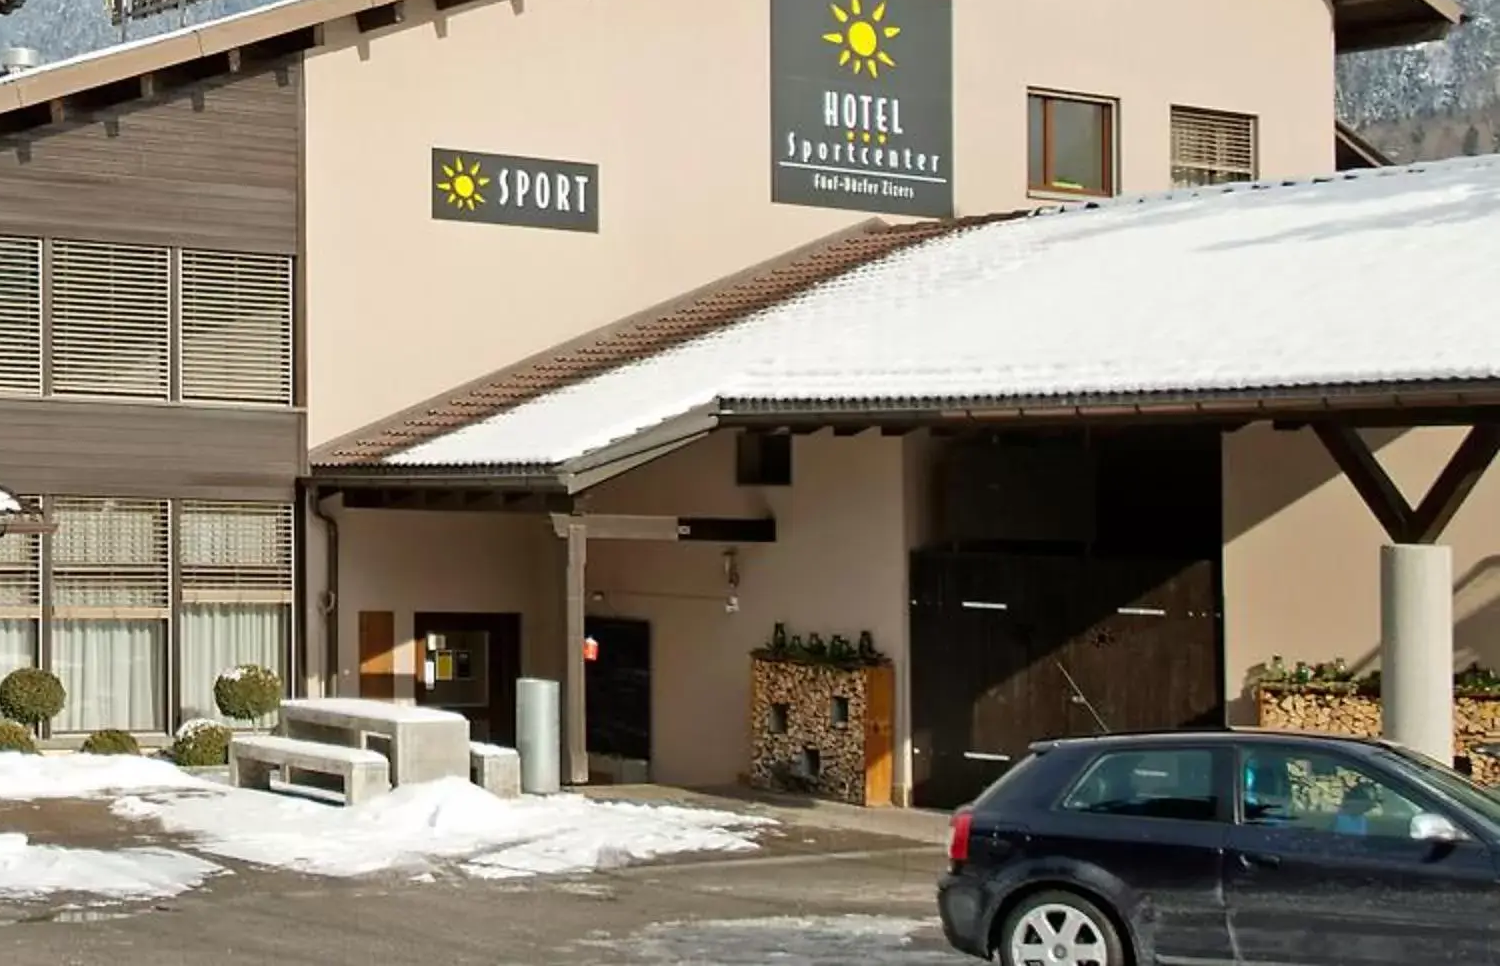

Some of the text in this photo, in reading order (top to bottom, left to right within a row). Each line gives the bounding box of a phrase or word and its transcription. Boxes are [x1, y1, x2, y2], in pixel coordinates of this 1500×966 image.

[824, 90, 903, 134] HOTEL
[787, 131, 940, 173] Sportcenter
[498, 168, 589, 213] SPORT
